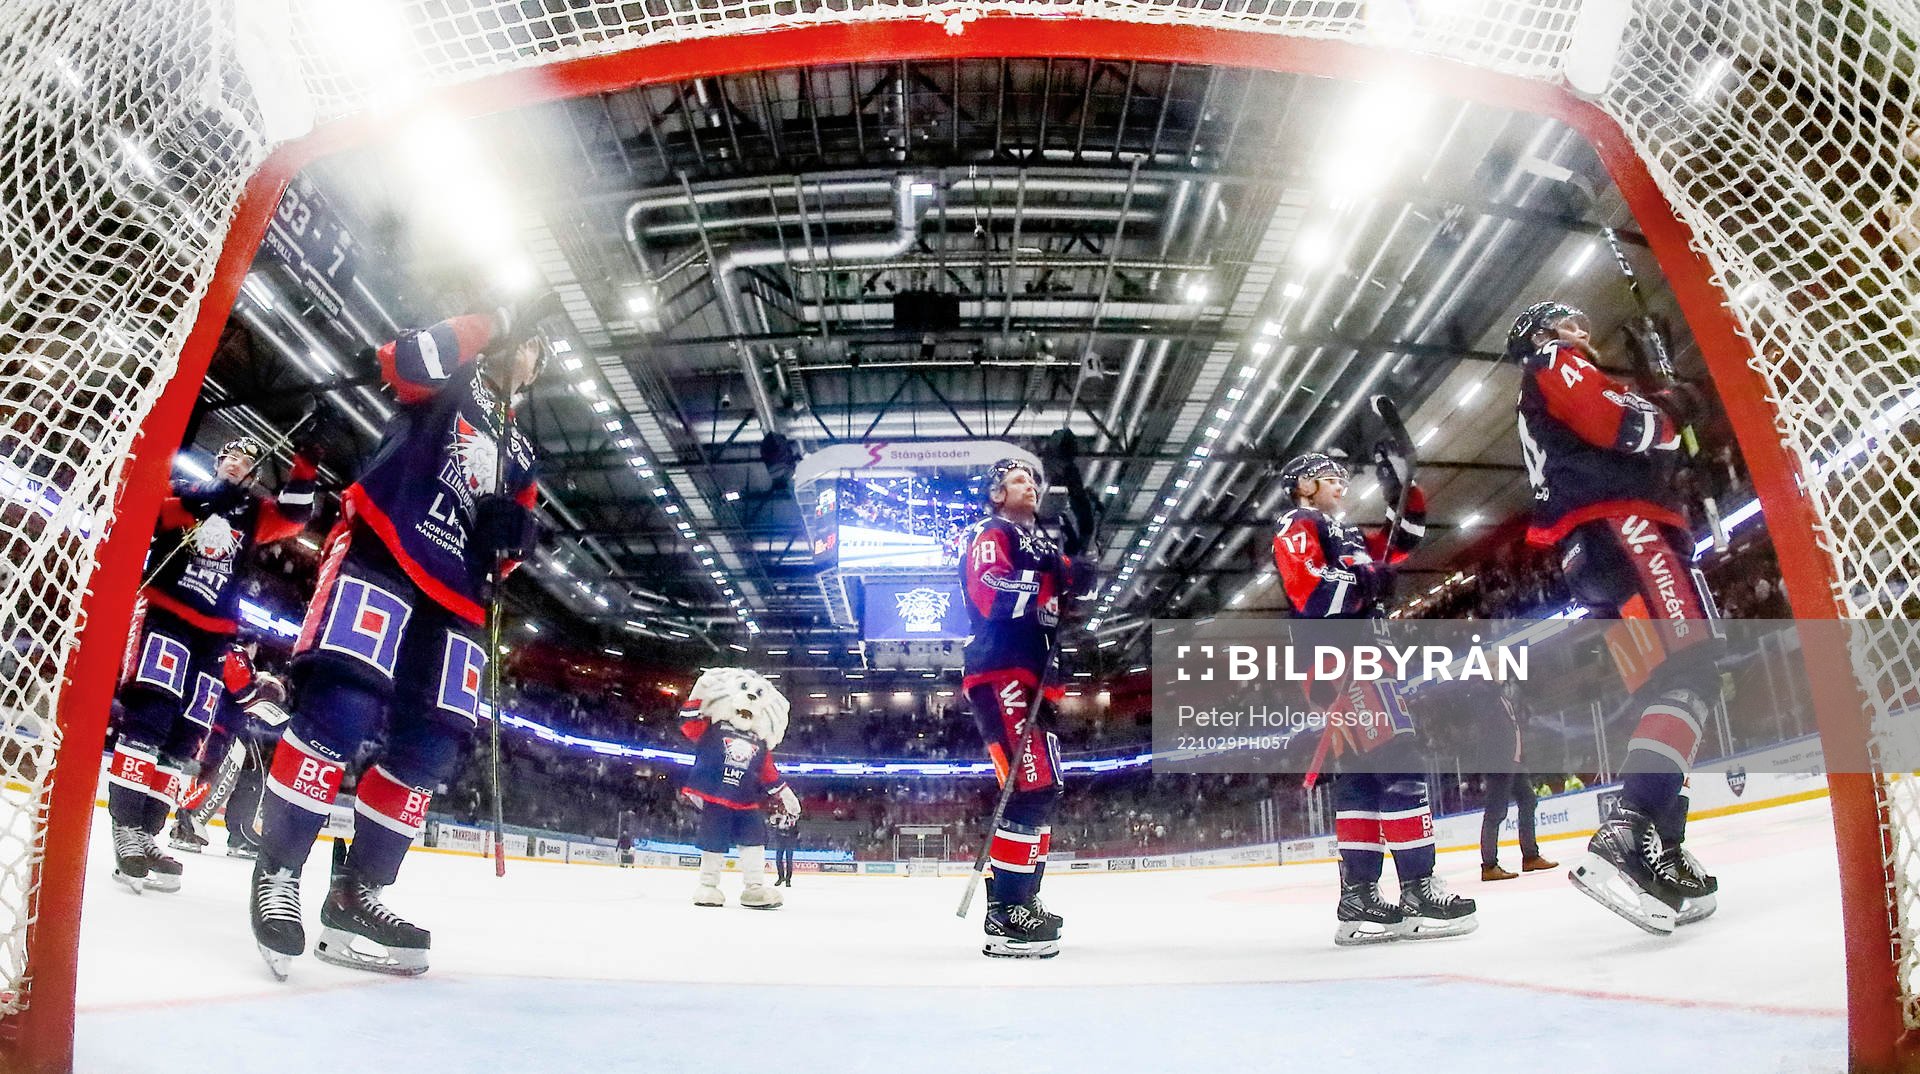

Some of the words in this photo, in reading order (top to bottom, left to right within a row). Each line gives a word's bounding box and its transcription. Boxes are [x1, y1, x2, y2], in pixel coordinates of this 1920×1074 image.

[278, 188, 311, 236] 33
[328, 245, 345, 278] 7
[1282, 532, 1307, 553] 17
[1648, 552, 1690, 638] Wilzéns
[310, 739, 342, 759] CCM
[123, 756, 147, 776] BC
[298, 757, 337, 789] BC
[121, 771, 143, 783] BYGG
[293, 778, 329, 801] BYGG
[1540, 810, 1569, 826] Event
